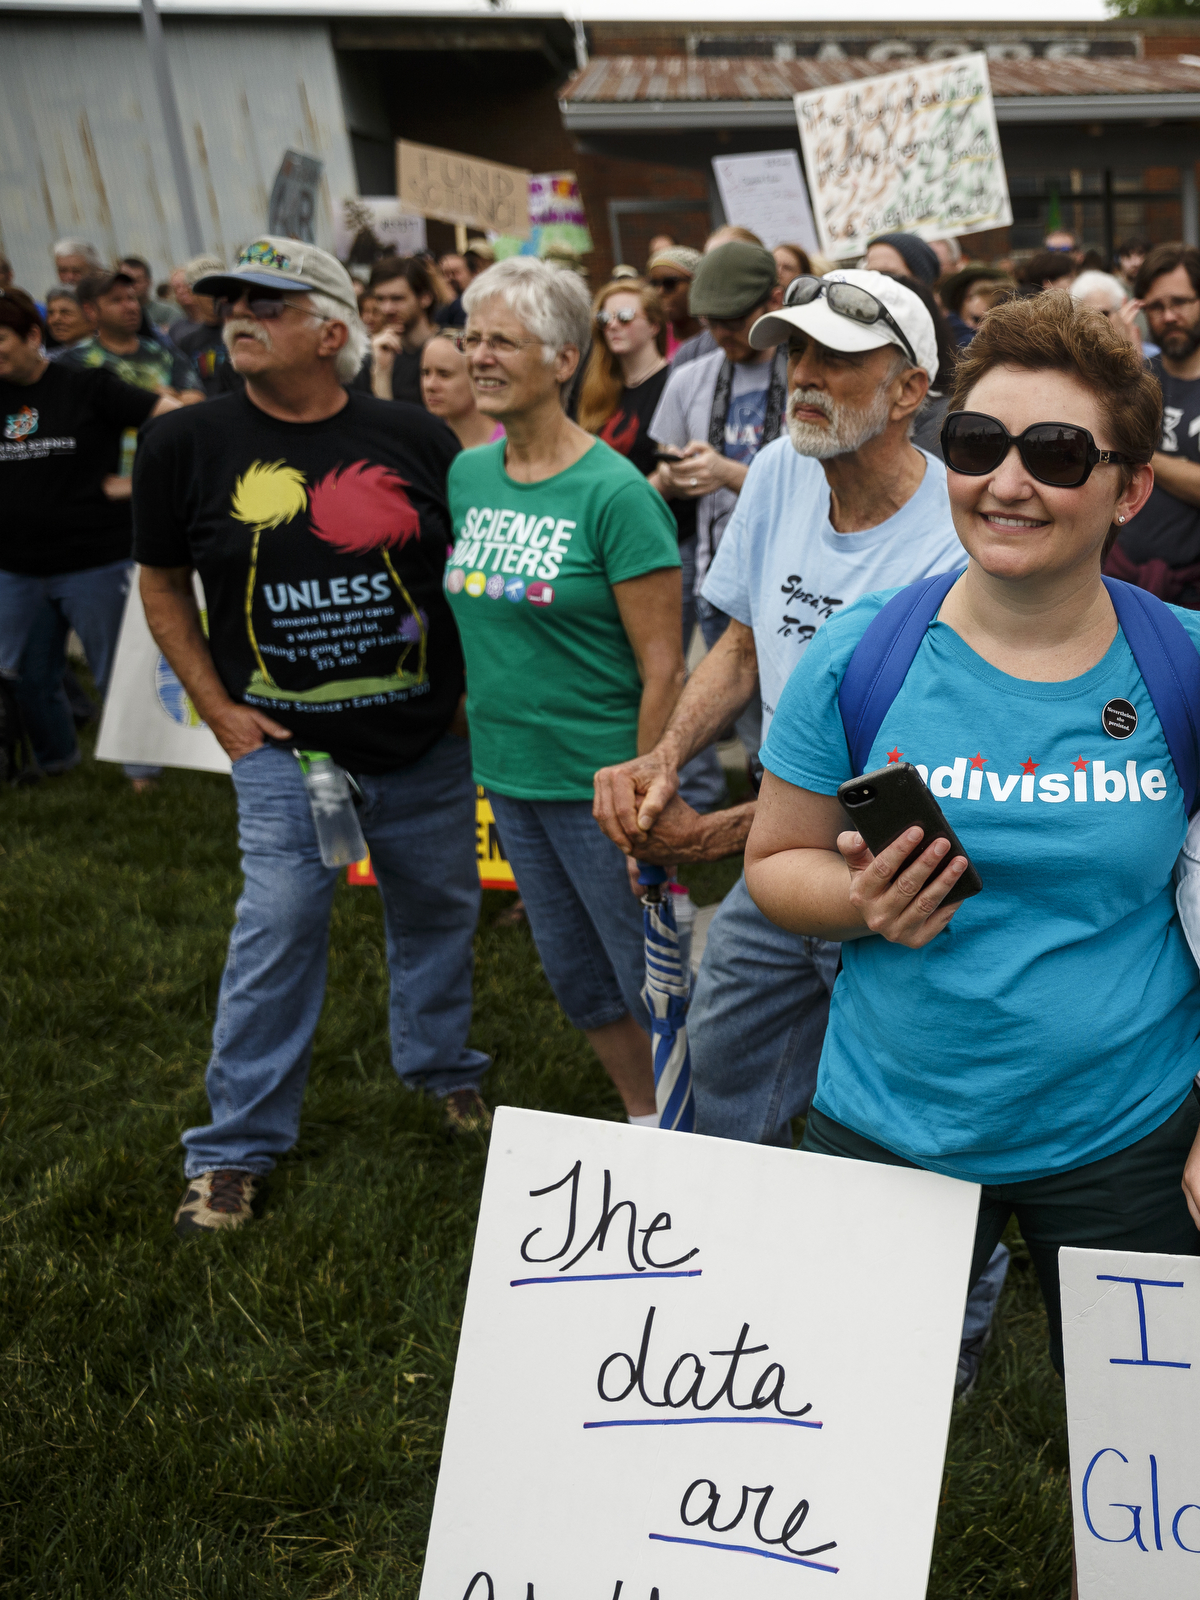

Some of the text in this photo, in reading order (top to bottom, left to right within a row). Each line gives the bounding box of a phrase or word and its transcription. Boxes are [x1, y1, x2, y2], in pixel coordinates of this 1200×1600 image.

[419, 154, 514, 200] FUND
[27, 436, 77, 452] SCIENCE
[461, 506, 577, 553] SCIENCE
[448, 539, 562, 580] MATTERS
[263, 572, 392, 612] UNLESS
[272, 604, 395, 628] someone like you cares
[286, 633, 295, 643] a
[297, 627, 329, 642] whole
[331, 624, 361, 637] awful
[298, 645, 308, 656] is
[309, 642, 341, 660] going
[342, 639, 356, 651] to
[356, 638, 377, 654] get
[294, 700, 343, 713] Science
[352, 692, 388, 709] Earth
[887, 746, 1167, 803] divisible
[520, 1159, 701, 1272] The
[1097, 1274, 1191, 1369] I
[597, 1305, 813, 1418] data
[680, 1477, 838, 1556] are
